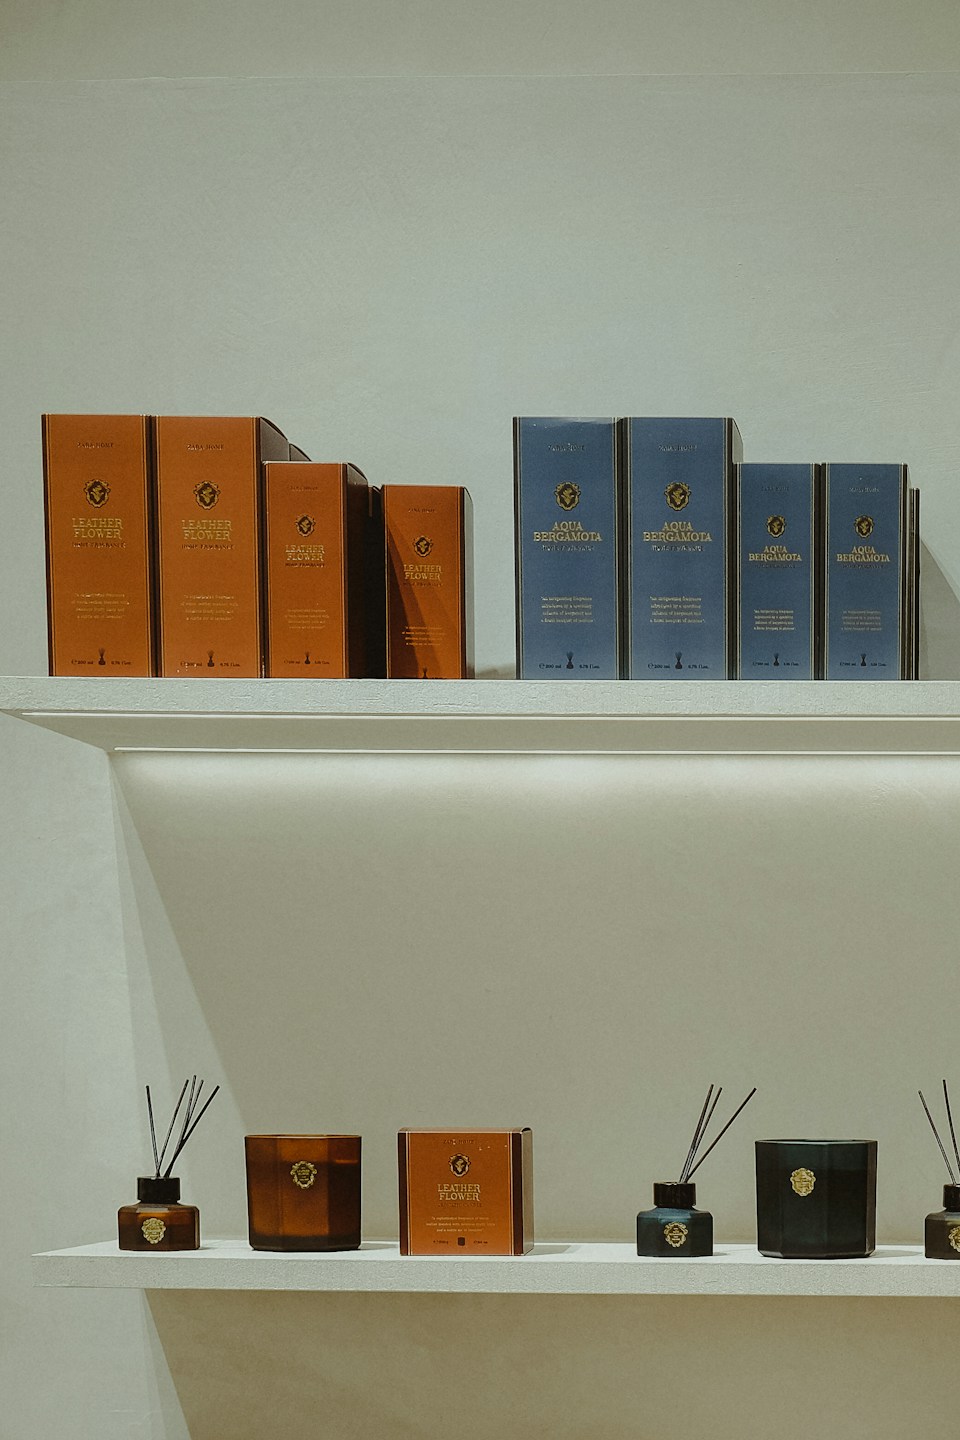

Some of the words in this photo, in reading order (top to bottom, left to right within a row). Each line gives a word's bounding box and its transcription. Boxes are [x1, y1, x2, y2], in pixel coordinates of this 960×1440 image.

[71, 518, 124, 530] LEATHER
[181, 520, 233, 531] LEATHER
[551, 521, 584, 532] AQUA
[661, 521, 693, 532] AQUA
[73, 529, 123, 540] FLOWER
[183, 530, 232, 541] FLOWER
[533, 531, 603, 543] BERGAMOTA
[642, 531, 712, 543] BERGAMOTA
[285, 544, 325, 554] LEATHER
[763, 545, 788, 554] AQUA
[851, 546, 876, 554] AQUA
[286, 553, 325, 562] FLOWER
[748, 553, 802, 562] BERGAMOTA
[836, 553, 890, 563] BERGAMOTA
[403, 564, 443, 574] LEATHER
[404, 572, 442, 581] FLOWER
[437, 1184, 481, 1193] LEATHER
[439, 1192, 481, 1202] FLOWER
